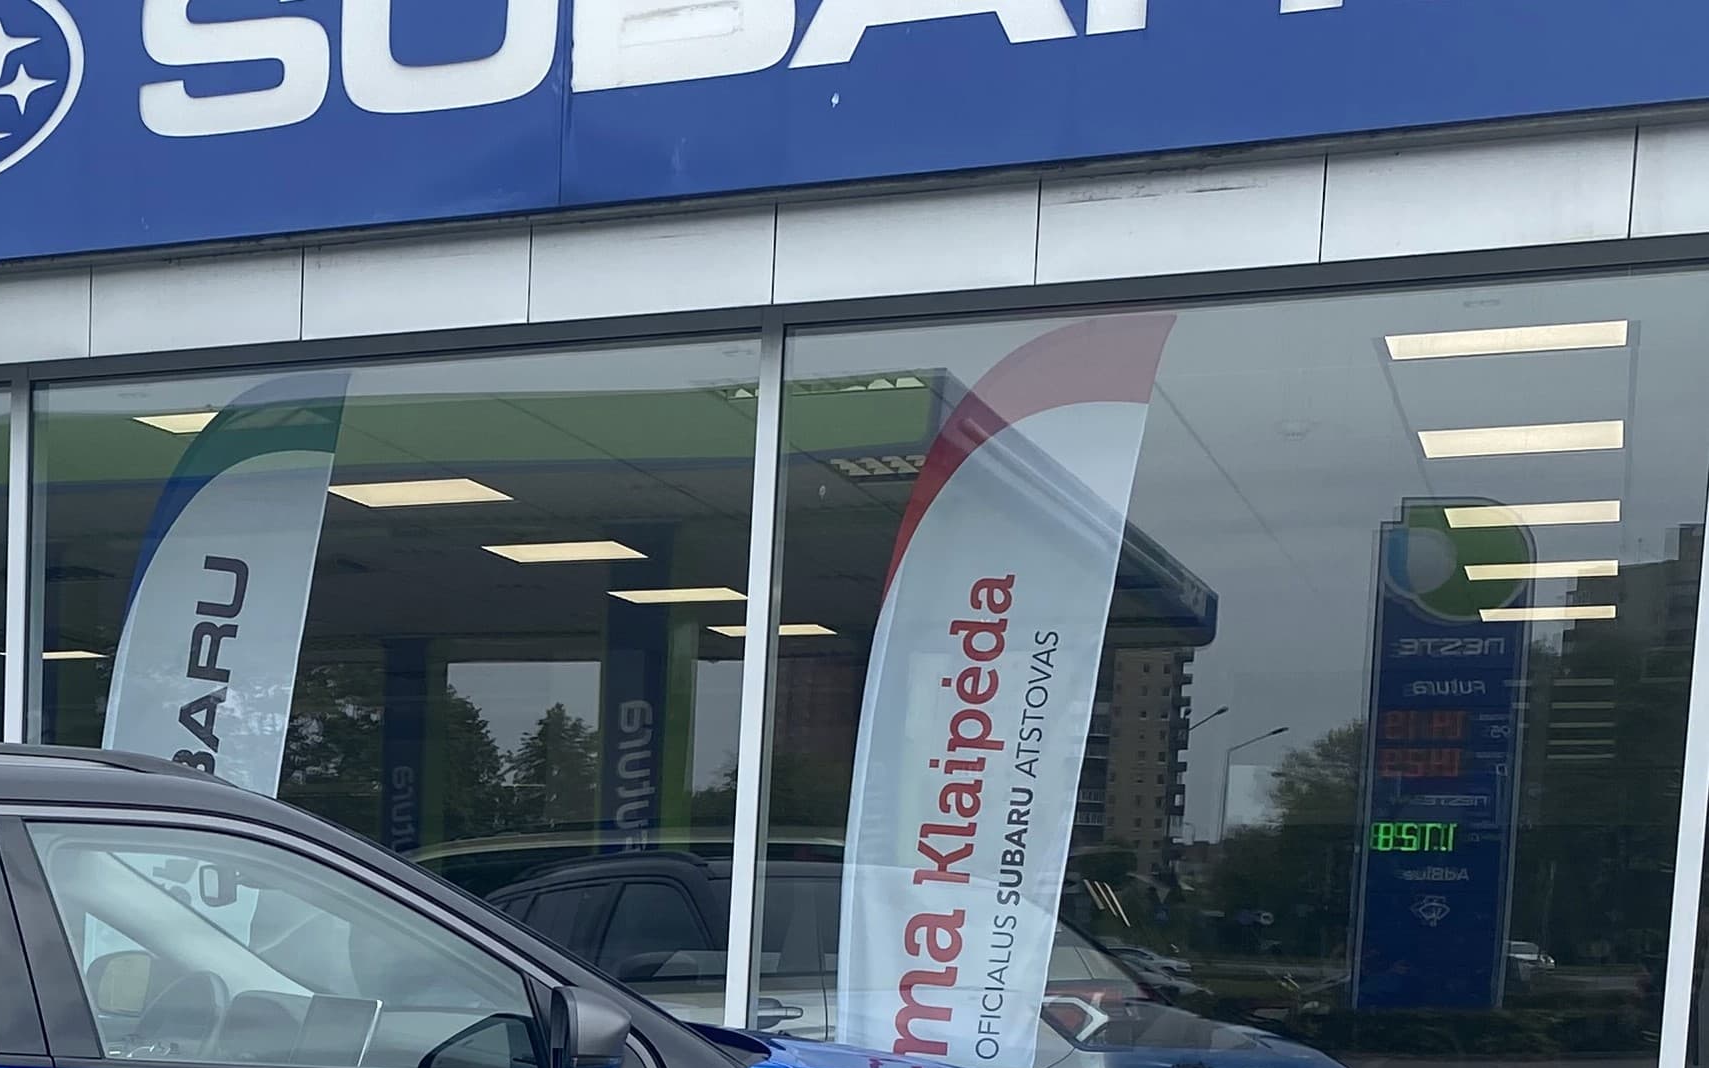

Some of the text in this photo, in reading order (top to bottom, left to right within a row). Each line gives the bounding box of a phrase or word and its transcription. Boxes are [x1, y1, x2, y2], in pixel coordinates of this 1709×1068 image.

[172, 555, 249, 774] BARU
[893, 574, 1015, 1057] ma Klaipėda
[975, 630, 1059, 1060] OFICIALUS SUBARU ATSTOVAS
